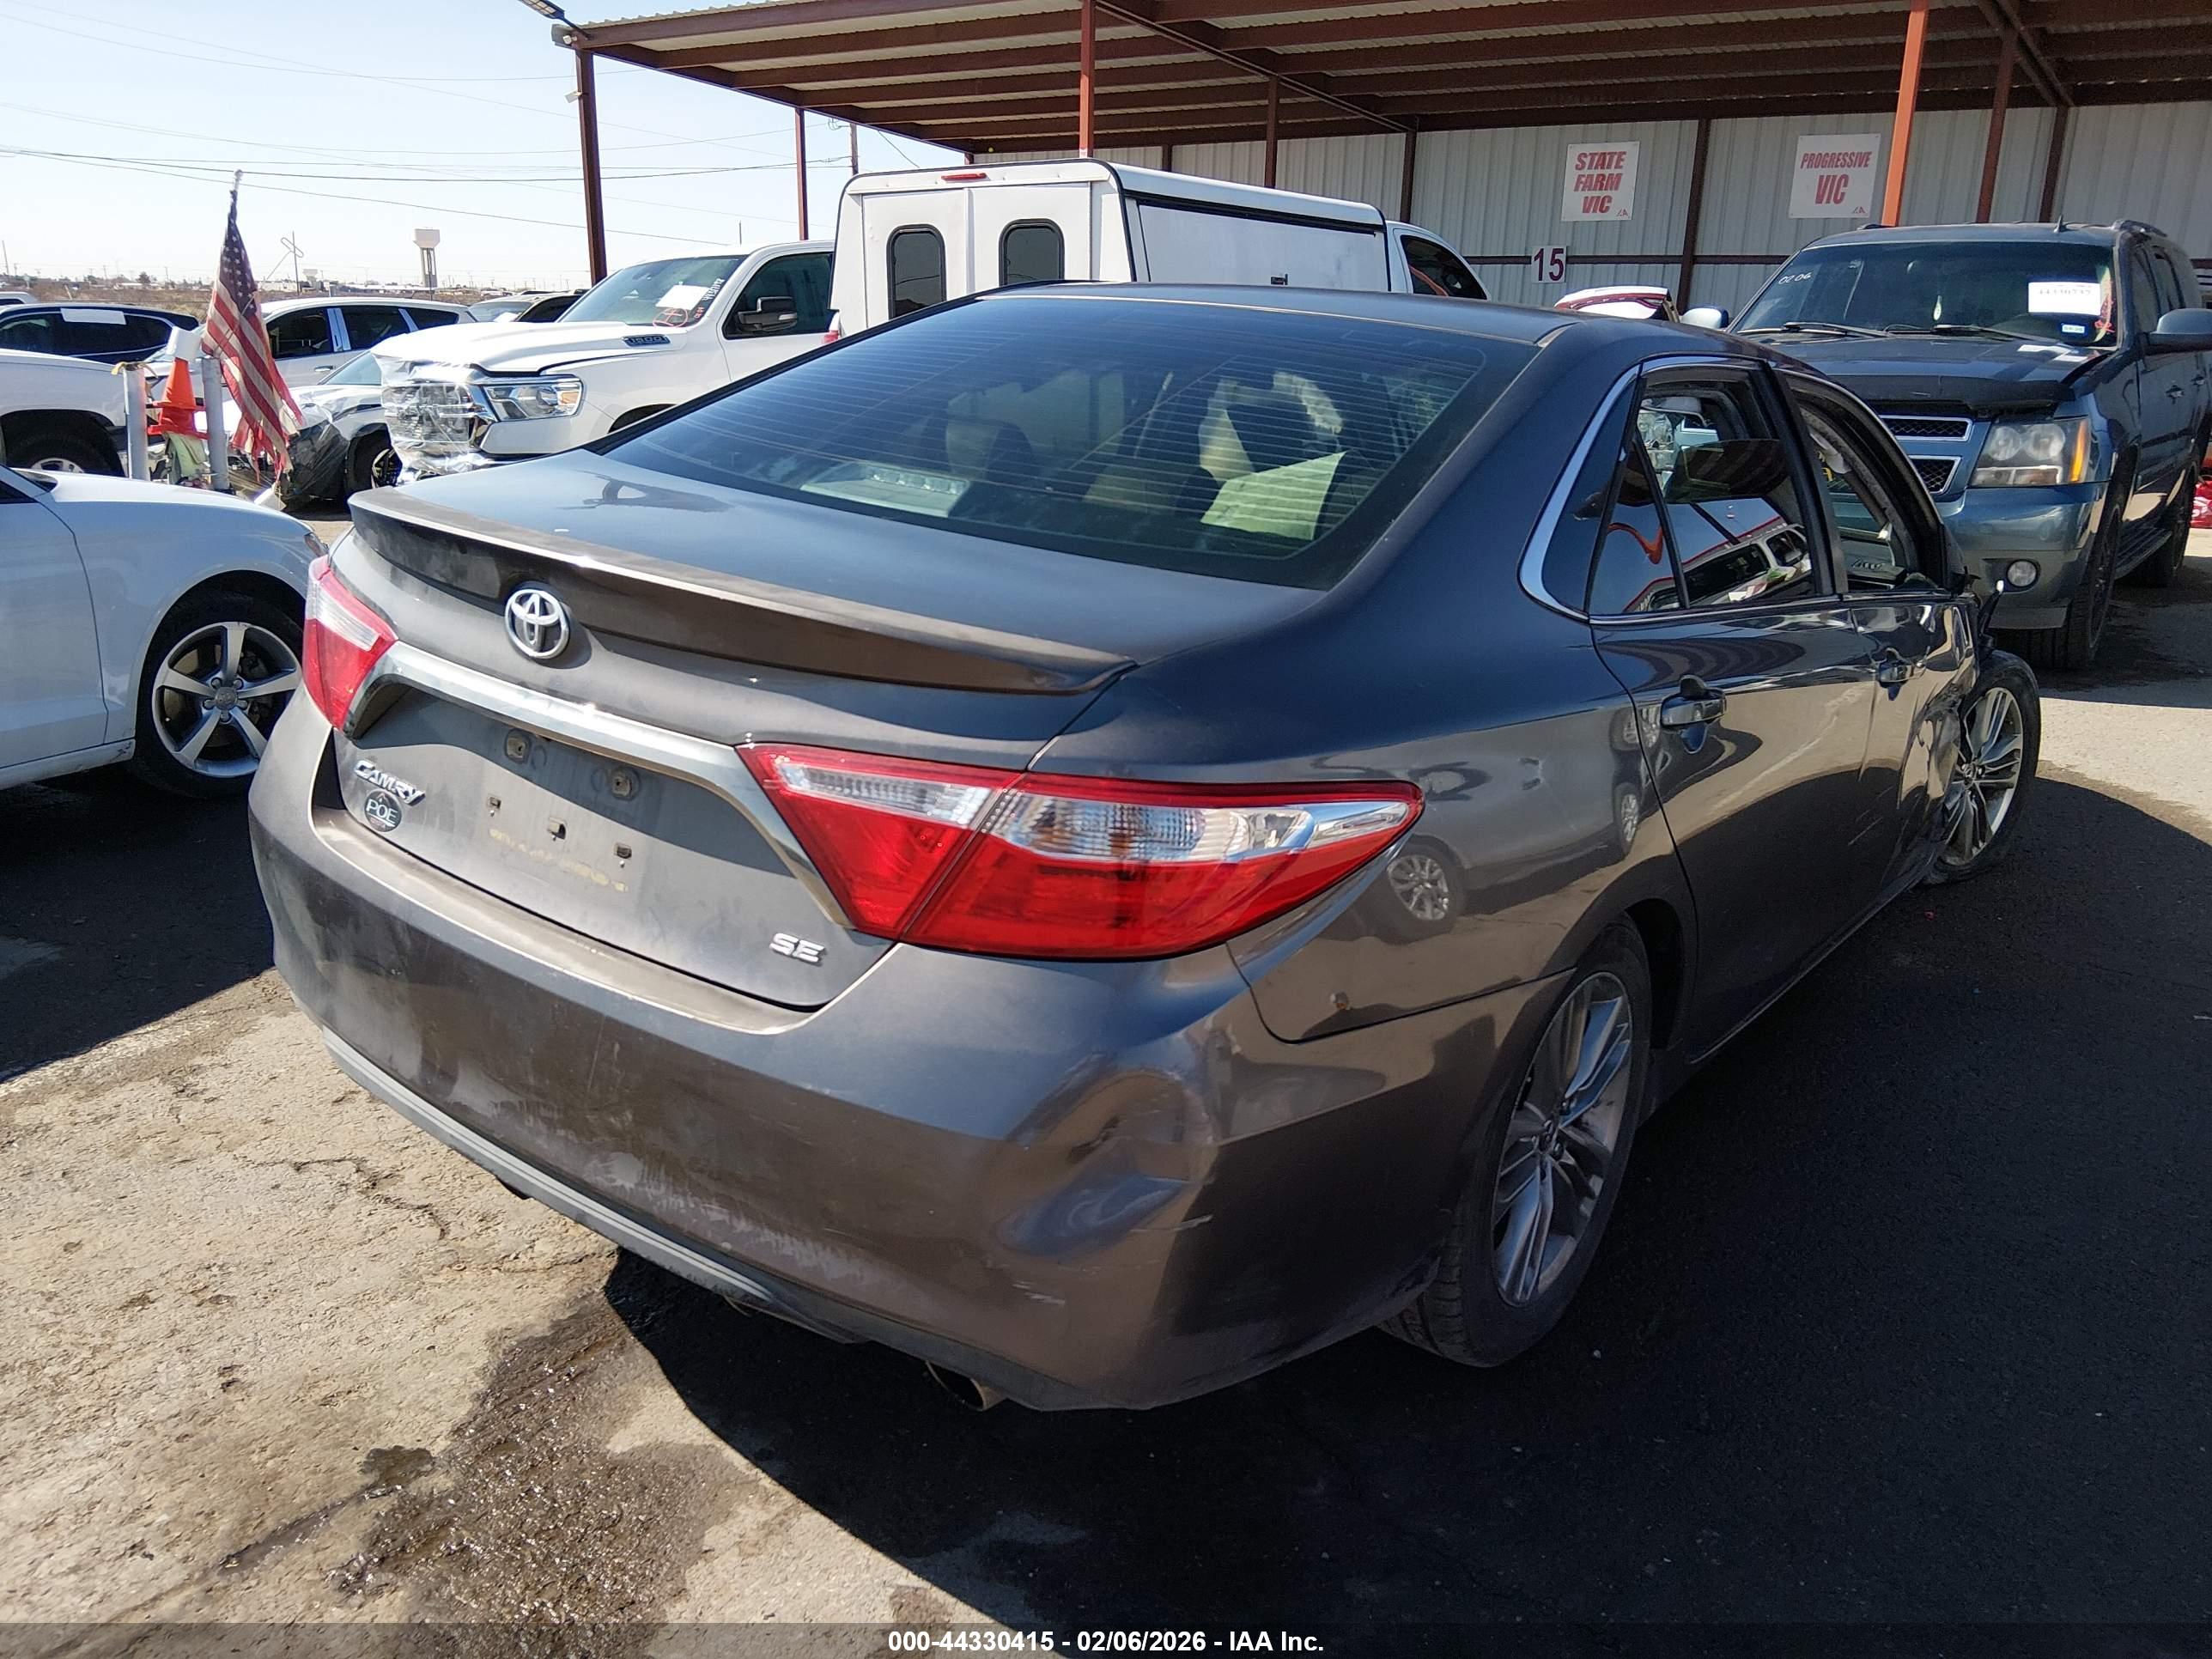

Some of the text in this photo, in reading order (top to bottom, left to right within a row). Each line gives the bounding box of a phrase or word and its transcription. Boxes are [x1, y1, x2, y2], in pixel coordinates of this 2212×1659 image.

[1575, 151, 1627, 170] STATE
[1800, 151, 1872, 169] PROGRESSIVE
[1573, 173, 1623, 191] FARM
[1815, 173, 1849, 204] VIC
[1582, 195, 1613, 214] VIC
[1534, 248, 1565, 282] 15
[1778, 275, 1795, 284] 02
[354, 760, 425, 806] CAMRY
[366, 799, 398, 824] POE
[769, 933, 826, 964] SE
